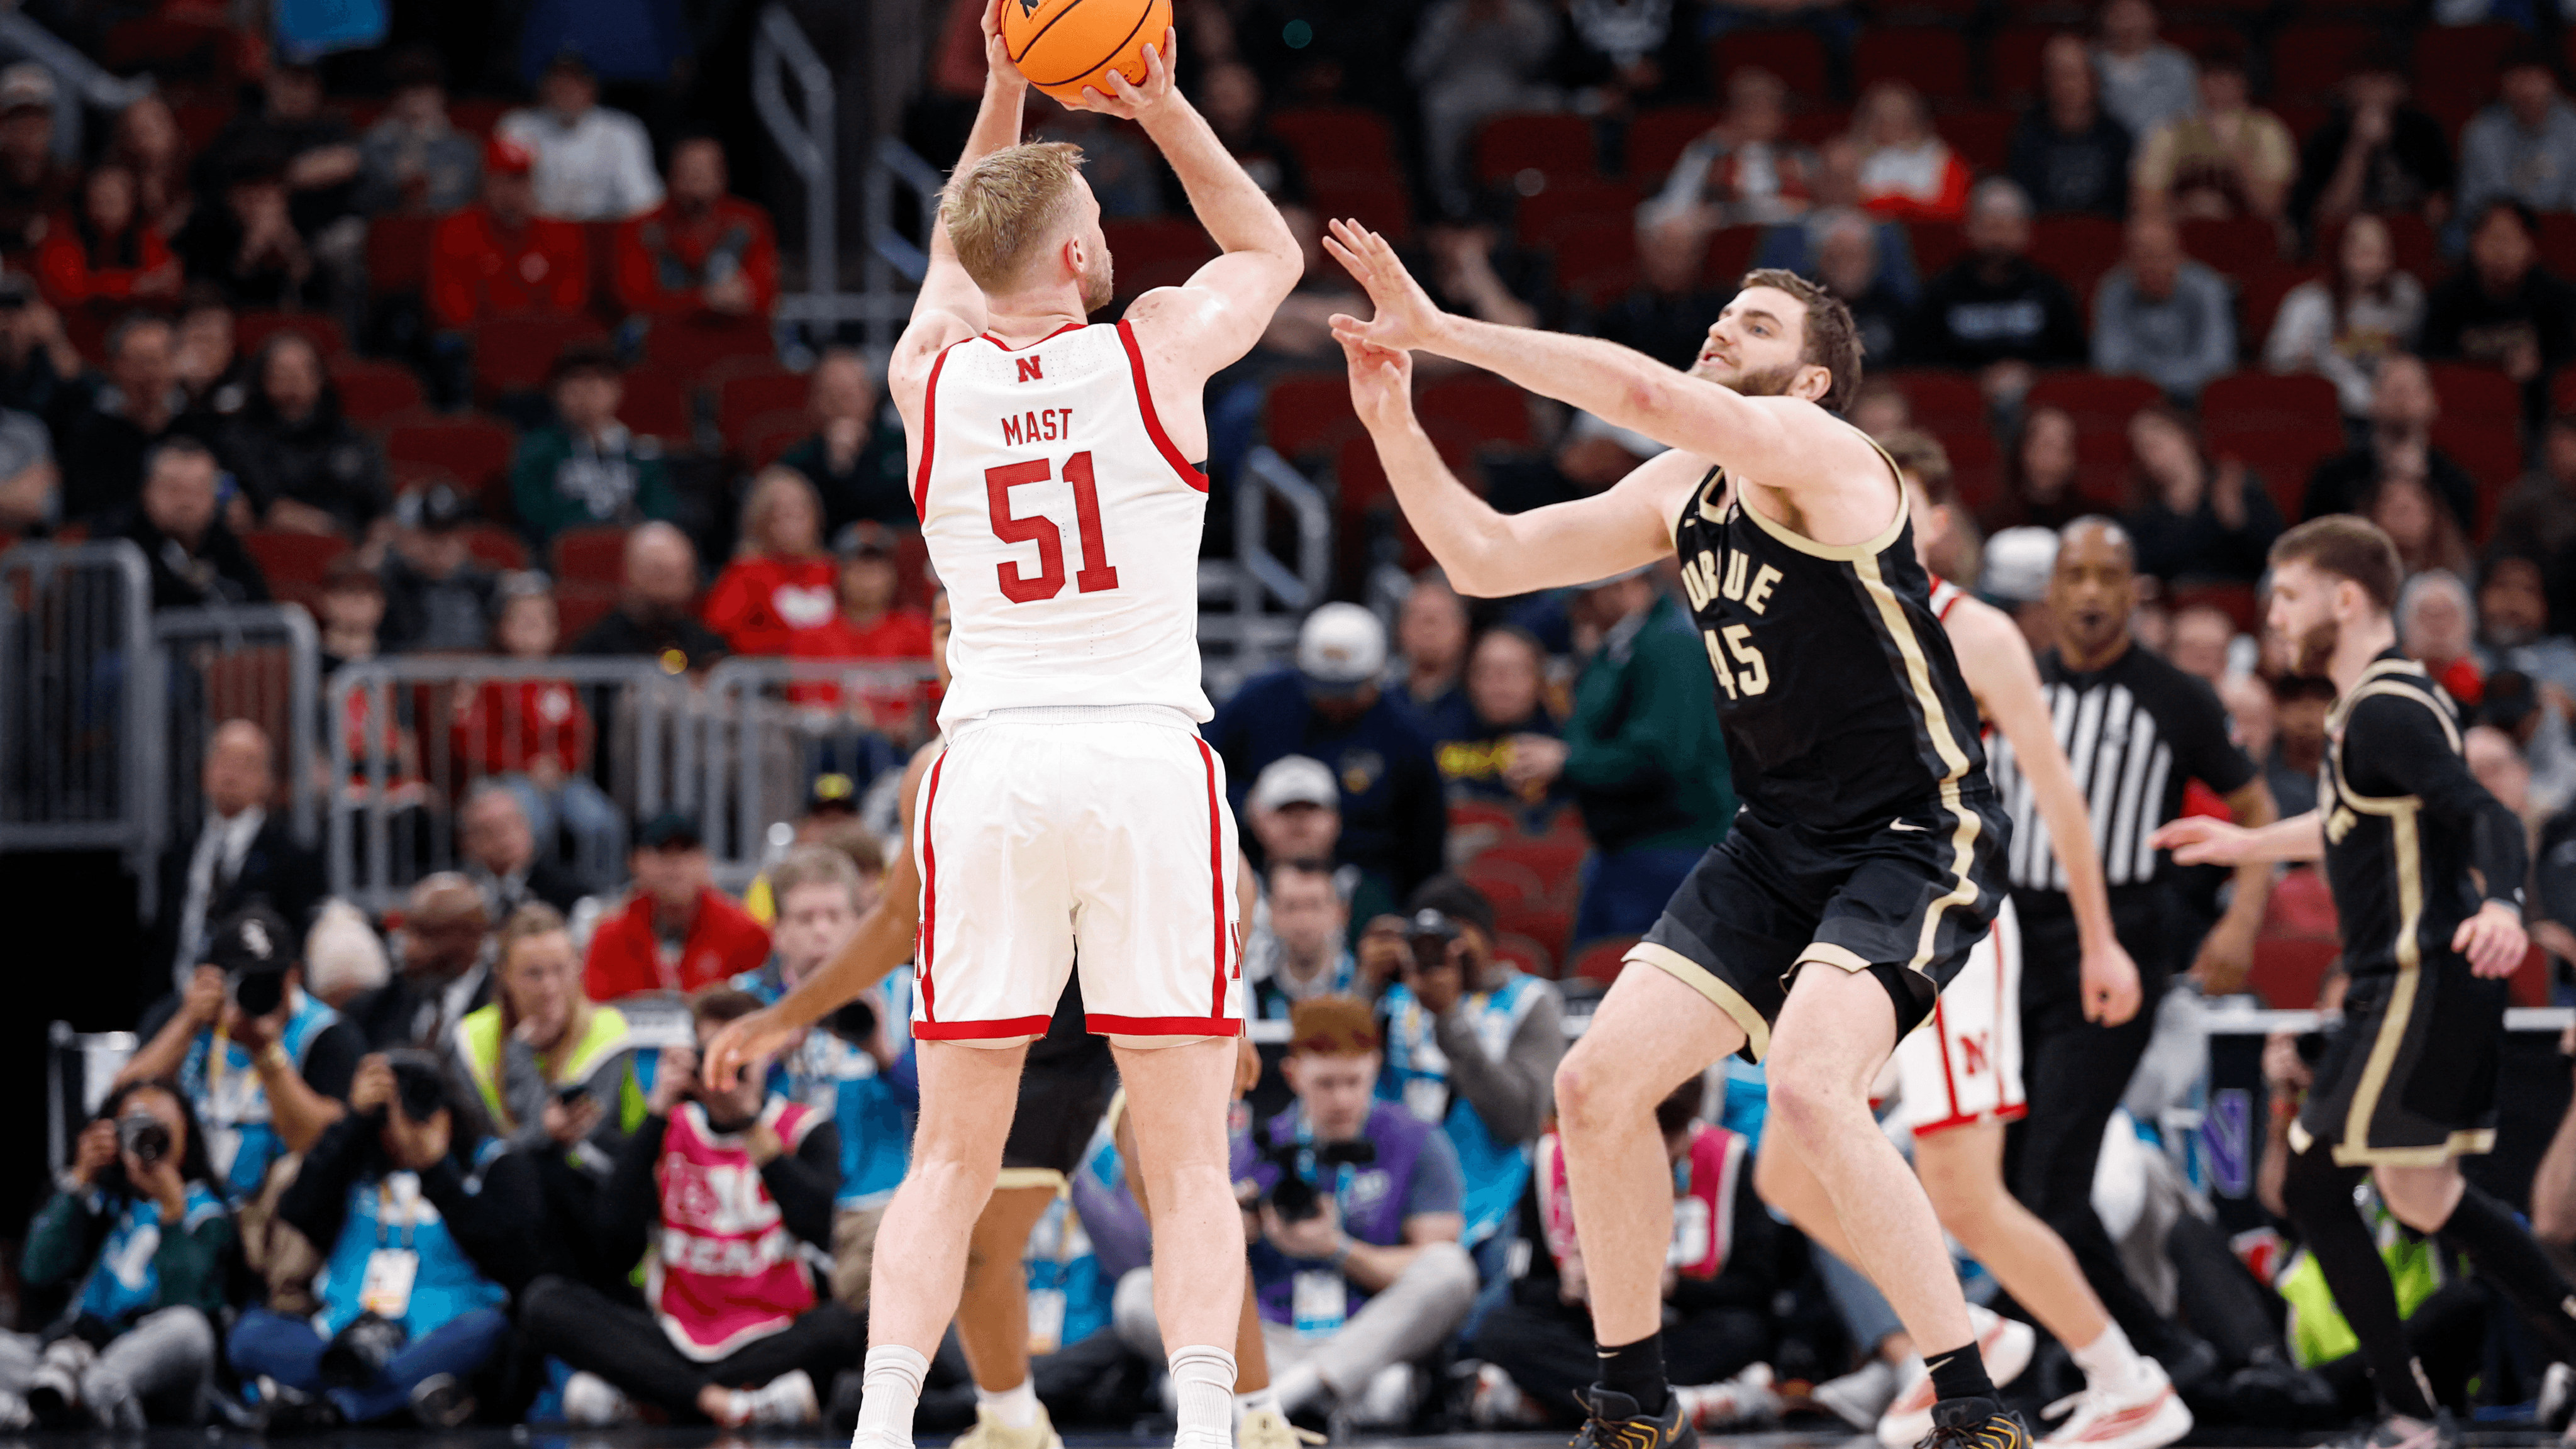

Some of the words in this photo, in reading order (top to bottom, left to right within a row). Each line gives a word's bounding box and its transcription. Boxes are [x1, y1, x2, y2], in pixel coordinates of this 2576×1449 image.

[1015, 355, 1043, 383] N
[1001, 408, 1073, 447] MAST
[984, 450, 1119, 604] 51
[1680, 548, 1784, 615] URUE
[1704, 623, 1770, 700] 45
